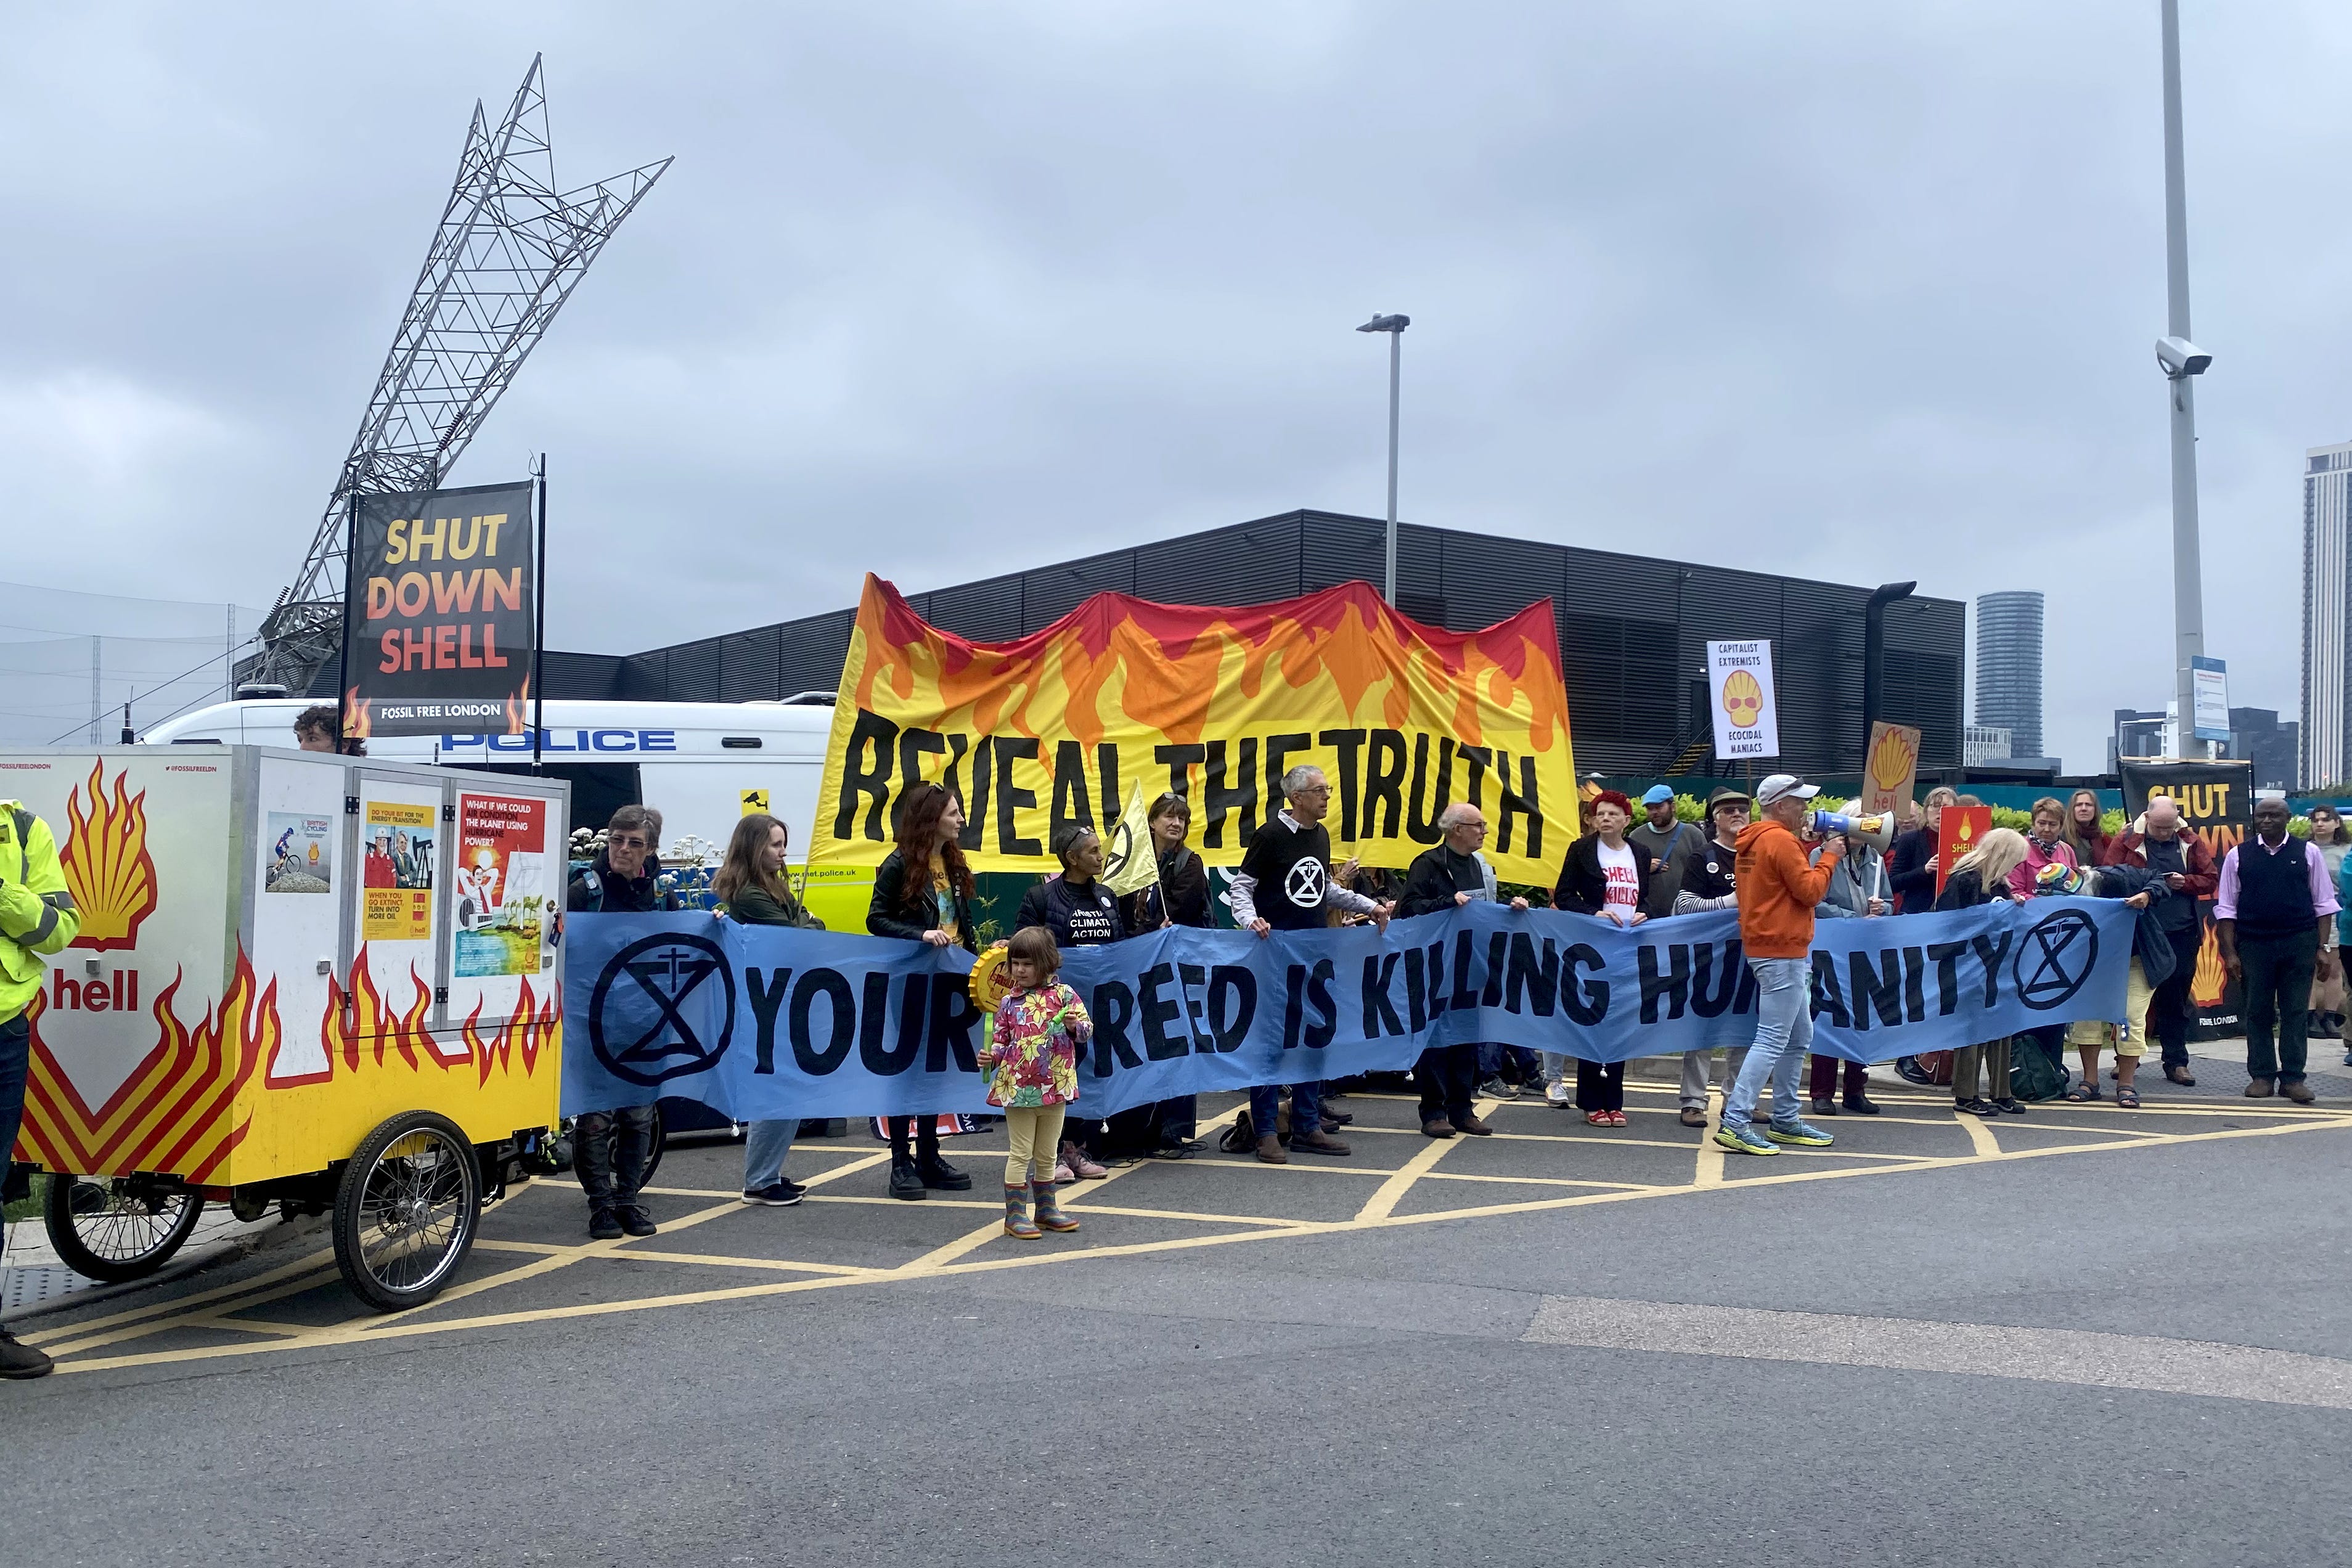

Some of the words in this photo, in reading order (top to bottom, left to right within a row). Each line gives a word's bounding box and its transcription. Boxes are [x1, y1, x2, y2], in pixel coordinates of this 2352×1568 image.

[385, 514, 507, 565] SHUT
[367, 567, 521, 619] DOWN
[379, 624, 508, 673] SHELL
[1719, 643, 1758, 653] CAPITALIST
[1719, 656, 1760, 666] EXTREMISTS
[381, 707, 414, 719] FOSSIL
[417, 706, 441, 717] FREE
[445, 704, 500, 716] LONDON
[441, 730, 677, 751] POLICE
[1729, 730, 1762, 740] ECOCIDAL
[1731, 743, 1762, 753] MANIACS
[1154, 733, 1312, 848] THE
[1319, 729, 1543, 858] TRUTH
[466, 800, 487, 809] WHAT
[489, 802, 494, 811] IF
[496, 802, 507, 811] WE
[508, 804, 531, 813] COULD
[1872, 793, 1897, 811] hell
[466, 809, 478, 819] AIR
[480, 811, 518, 821] CONDITION
[465, 818, 478, 827] THE
[480, 819, 505, 829] PLANET
[506, 821, 528, 831] USING
[465, 828, 504, 838] HURRICANE
[464, 837, 494, 847] POWER?
[1072, 929, 1111, 938] ACTION
[53, 968, 138, 1011] hell
[746, 966, 982, 1076] YOUR
[1077, 962, 1257, 1078] REED
[1283, 959, 1336, 1049] IS
[1362, 929, 1609, 1039] KILLING
